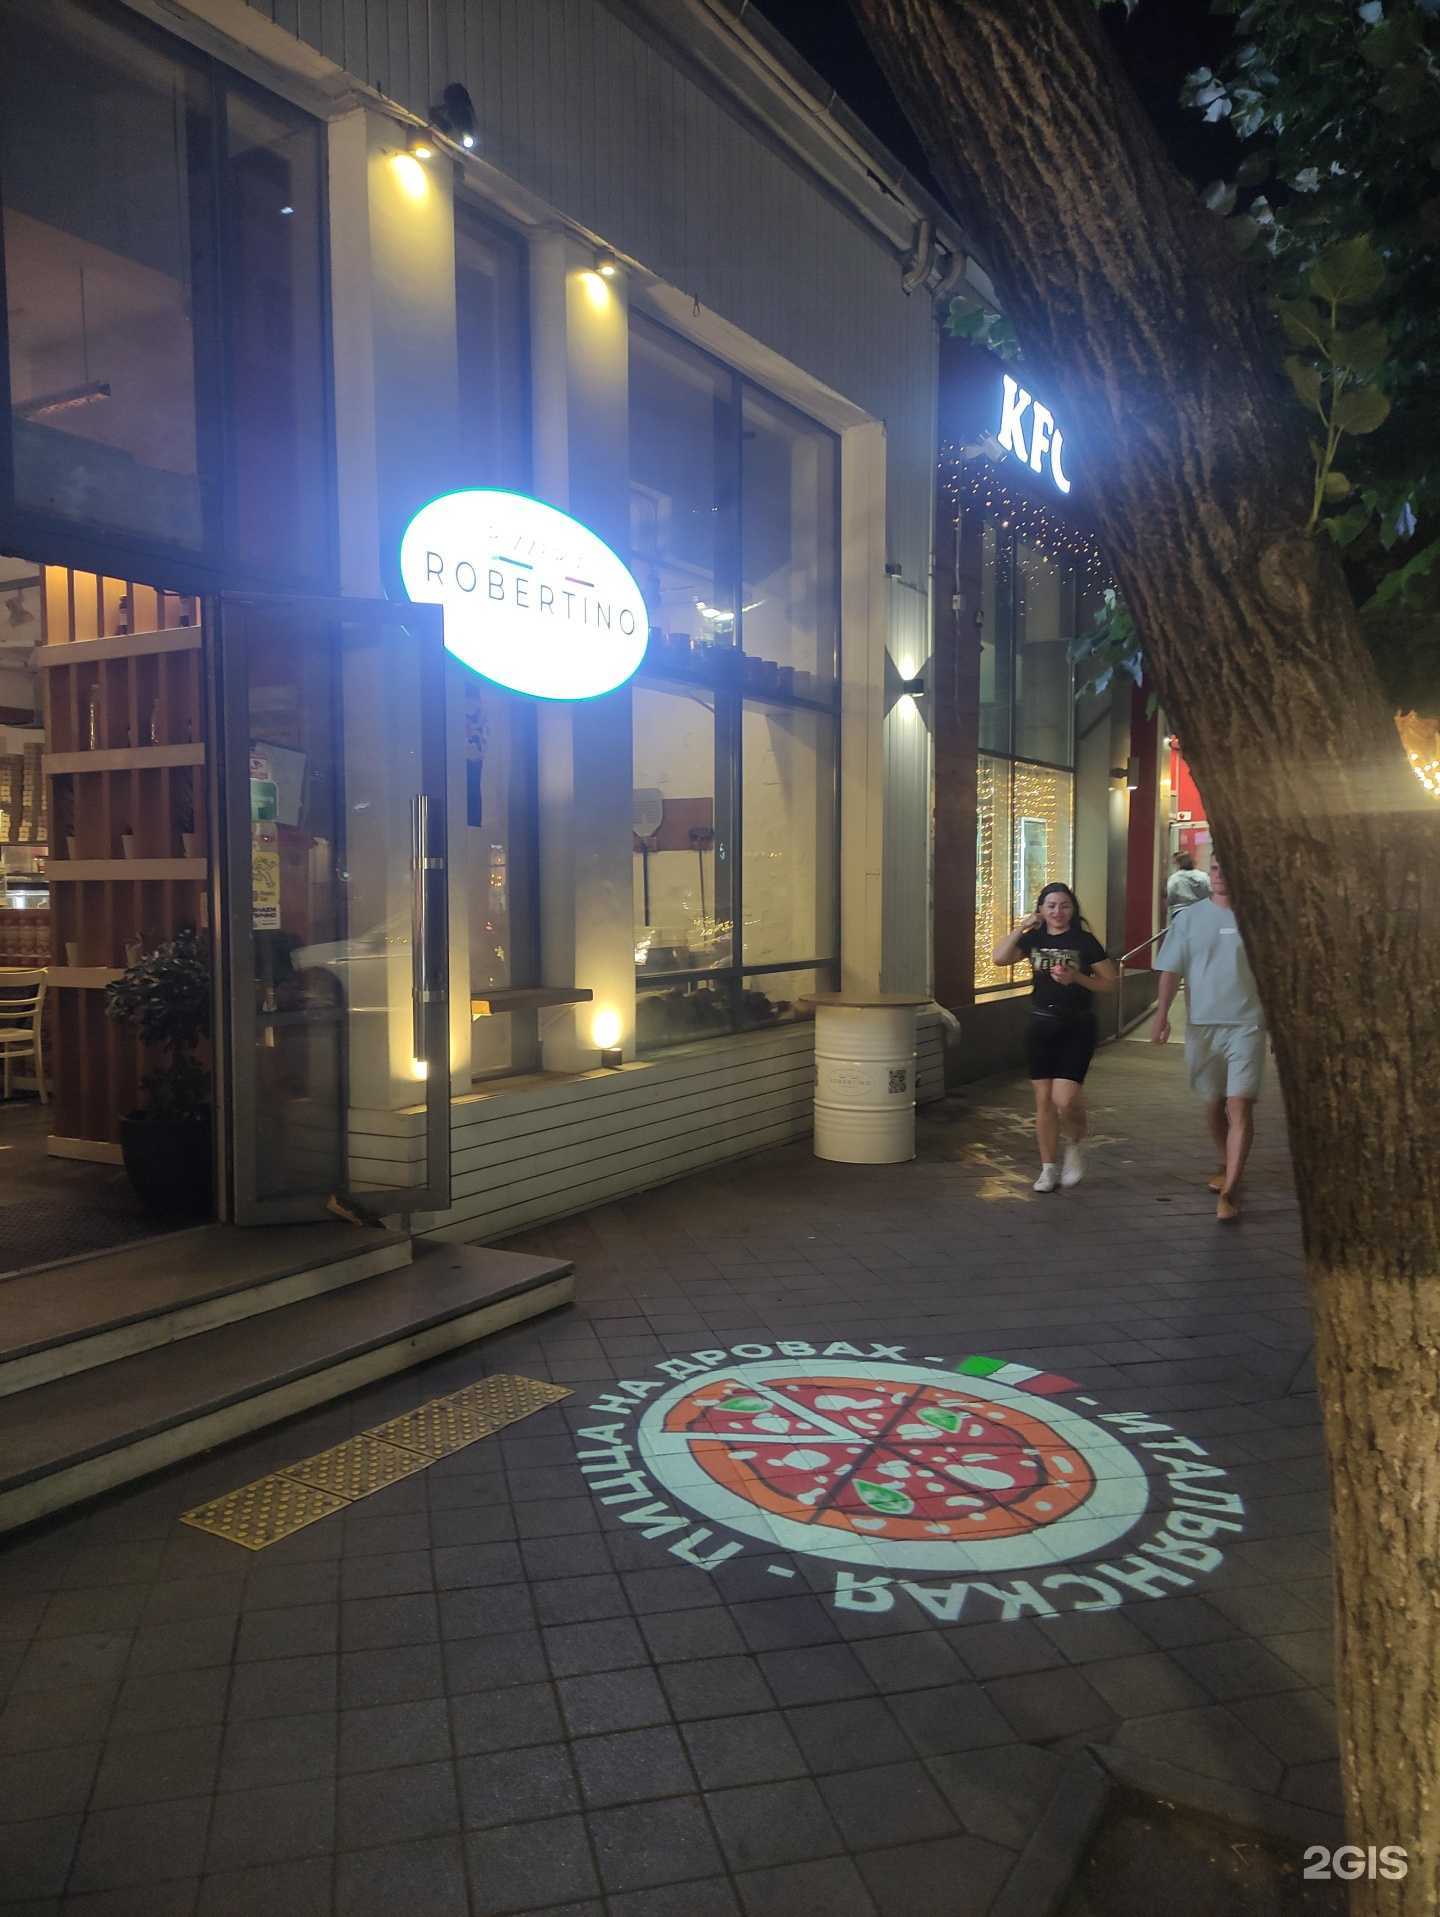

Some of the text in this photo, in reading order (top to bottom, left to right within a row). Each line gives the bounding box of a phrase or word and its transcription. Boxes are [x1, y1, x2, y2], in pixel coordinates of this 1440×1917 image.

[426, 551, 635, 635] ROBERTINO
[577, 1341, 906, 1570] ПИЦЦА НА ДРОВАХ
[832, 1411, 1246, 1621] ИТАЛЬЯНСКАЯ
